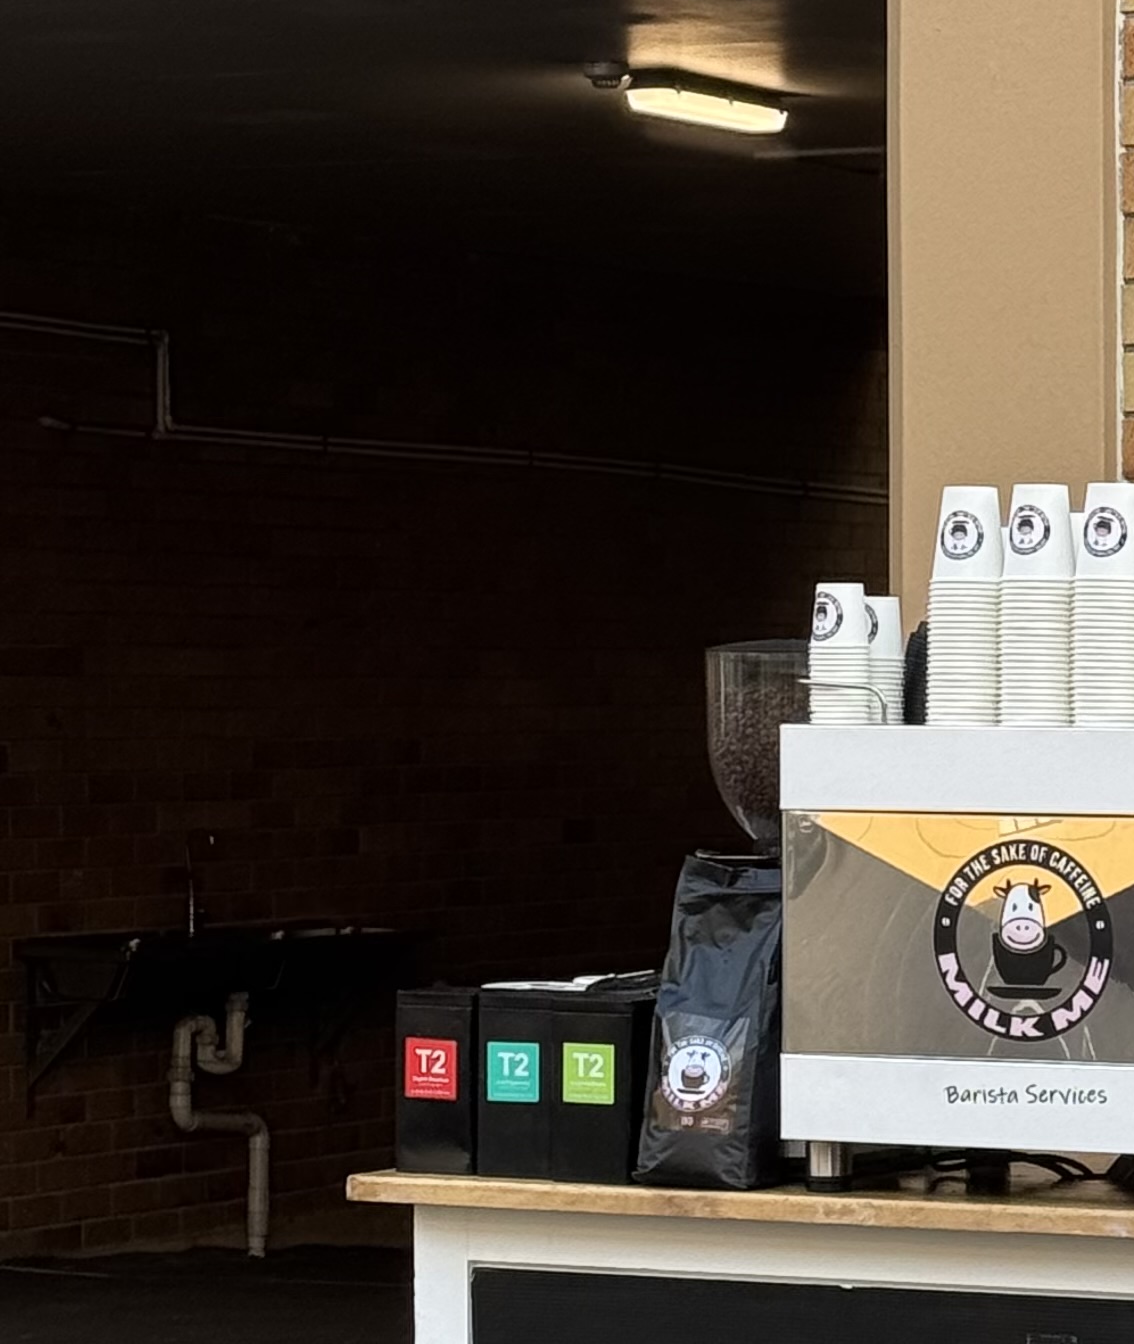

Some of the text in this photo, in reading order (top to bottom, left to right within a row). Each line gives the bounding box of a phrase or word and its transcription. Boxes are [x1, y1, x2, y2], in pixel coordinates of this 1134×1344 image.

[944, 843, 1101, 910] FOR THE SAKE OF CAFFEINE
[938, 952, 1110, 1037] MILK ME
[414, 1047, 446, 1075] T2
[497, 1051, 530, 1077] T2
[572, 1051, 605, 1078] T2
[944, 1083, 1108, 1105] Barista Services
